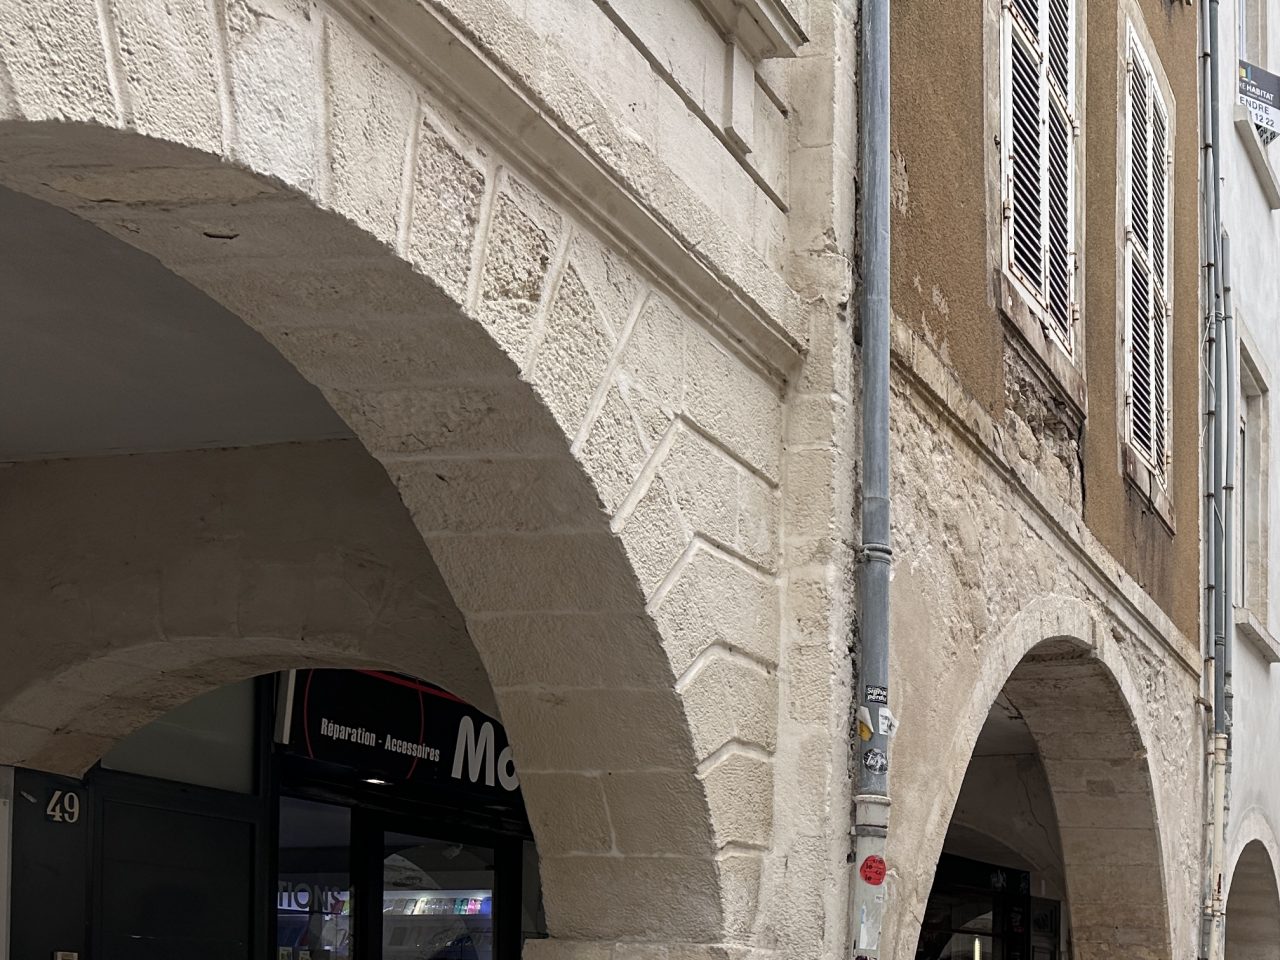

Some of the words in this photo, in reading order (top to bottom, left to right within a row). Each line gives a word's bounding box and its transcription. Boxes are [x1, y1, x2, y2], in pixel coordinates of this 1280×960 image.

[1240, 96, 1270, 115] ENDRE
[1246, 84, 1274, 101] HABITAT
[320, 717, 376, 747] Réparation
[384, 734, 440, 762] Accessoires
[47, 790, 80, 823] 49
